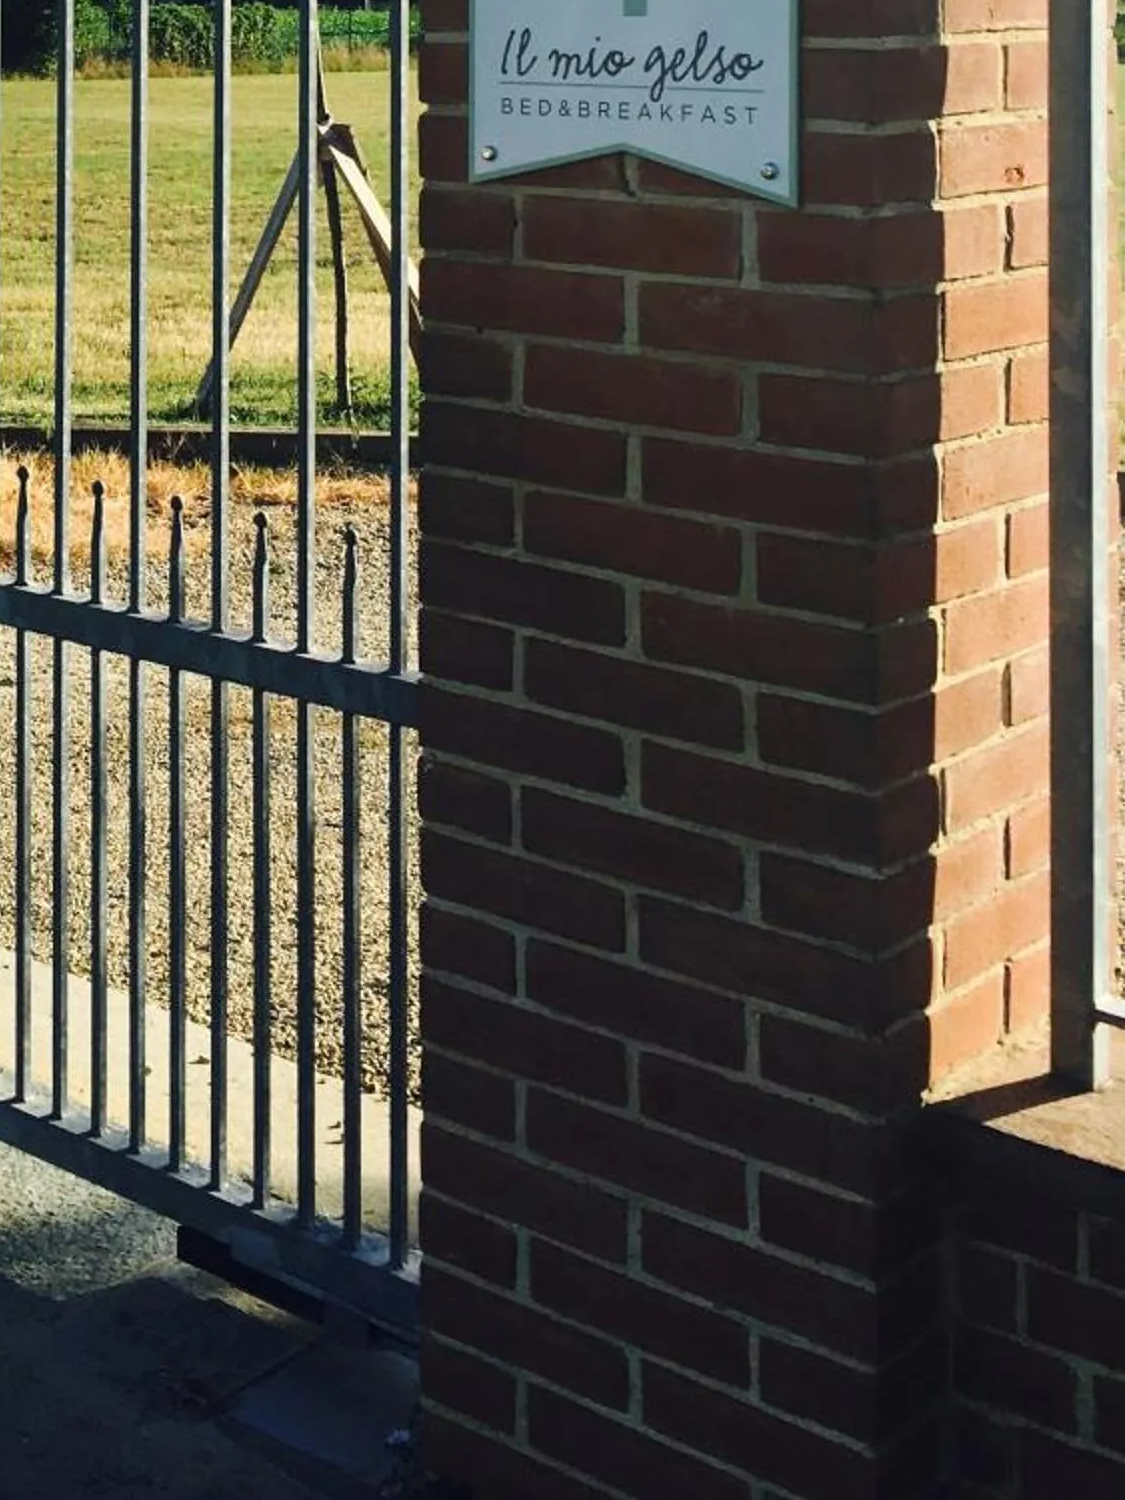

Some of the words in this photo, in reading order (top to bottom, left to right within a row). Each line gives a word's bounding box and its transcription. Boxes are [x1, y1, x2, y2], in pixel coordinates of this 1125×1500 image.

[500, 27, 538, 76] Il
[548, 36, 635, 80] mio
[643, 30, 764, 102] gelso
[500, 97, 758, 125] BED&BREAKFAST
